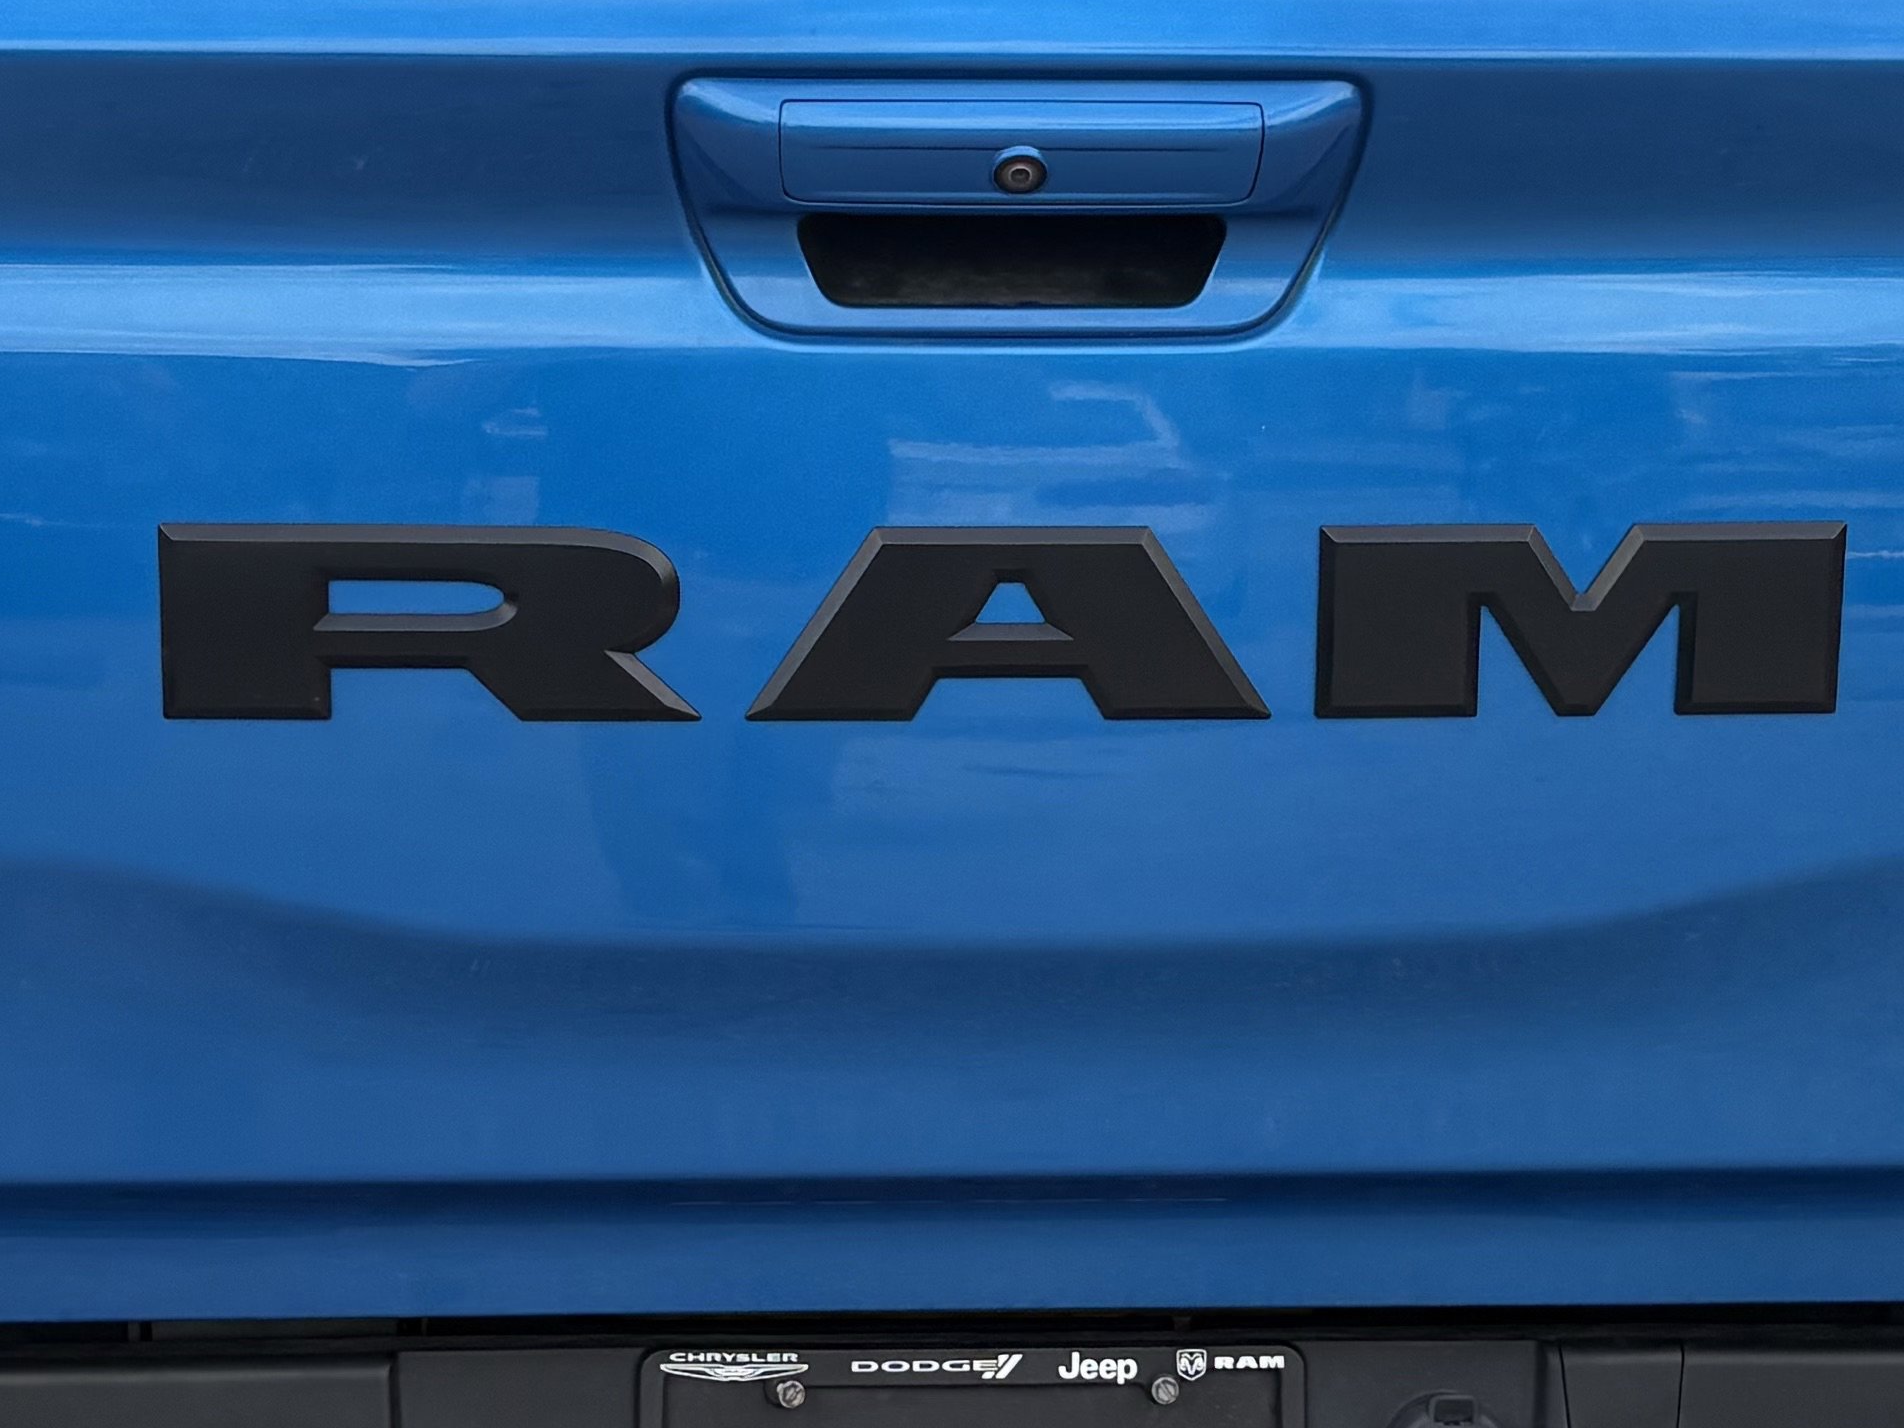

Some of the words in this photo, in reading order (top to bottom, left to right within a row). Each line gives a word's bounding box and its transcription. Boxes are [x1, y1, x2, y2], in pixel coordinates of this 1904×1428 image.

[158, 521, 1848, 722] RAM
[668, 1352, 799, 1363] CHRYSLER
[850, 1359, 999, 1373] DODGE
[1057, 1351, 1138, 1385] Jeep
[1213, 1355, 1286, 1370] RAM
